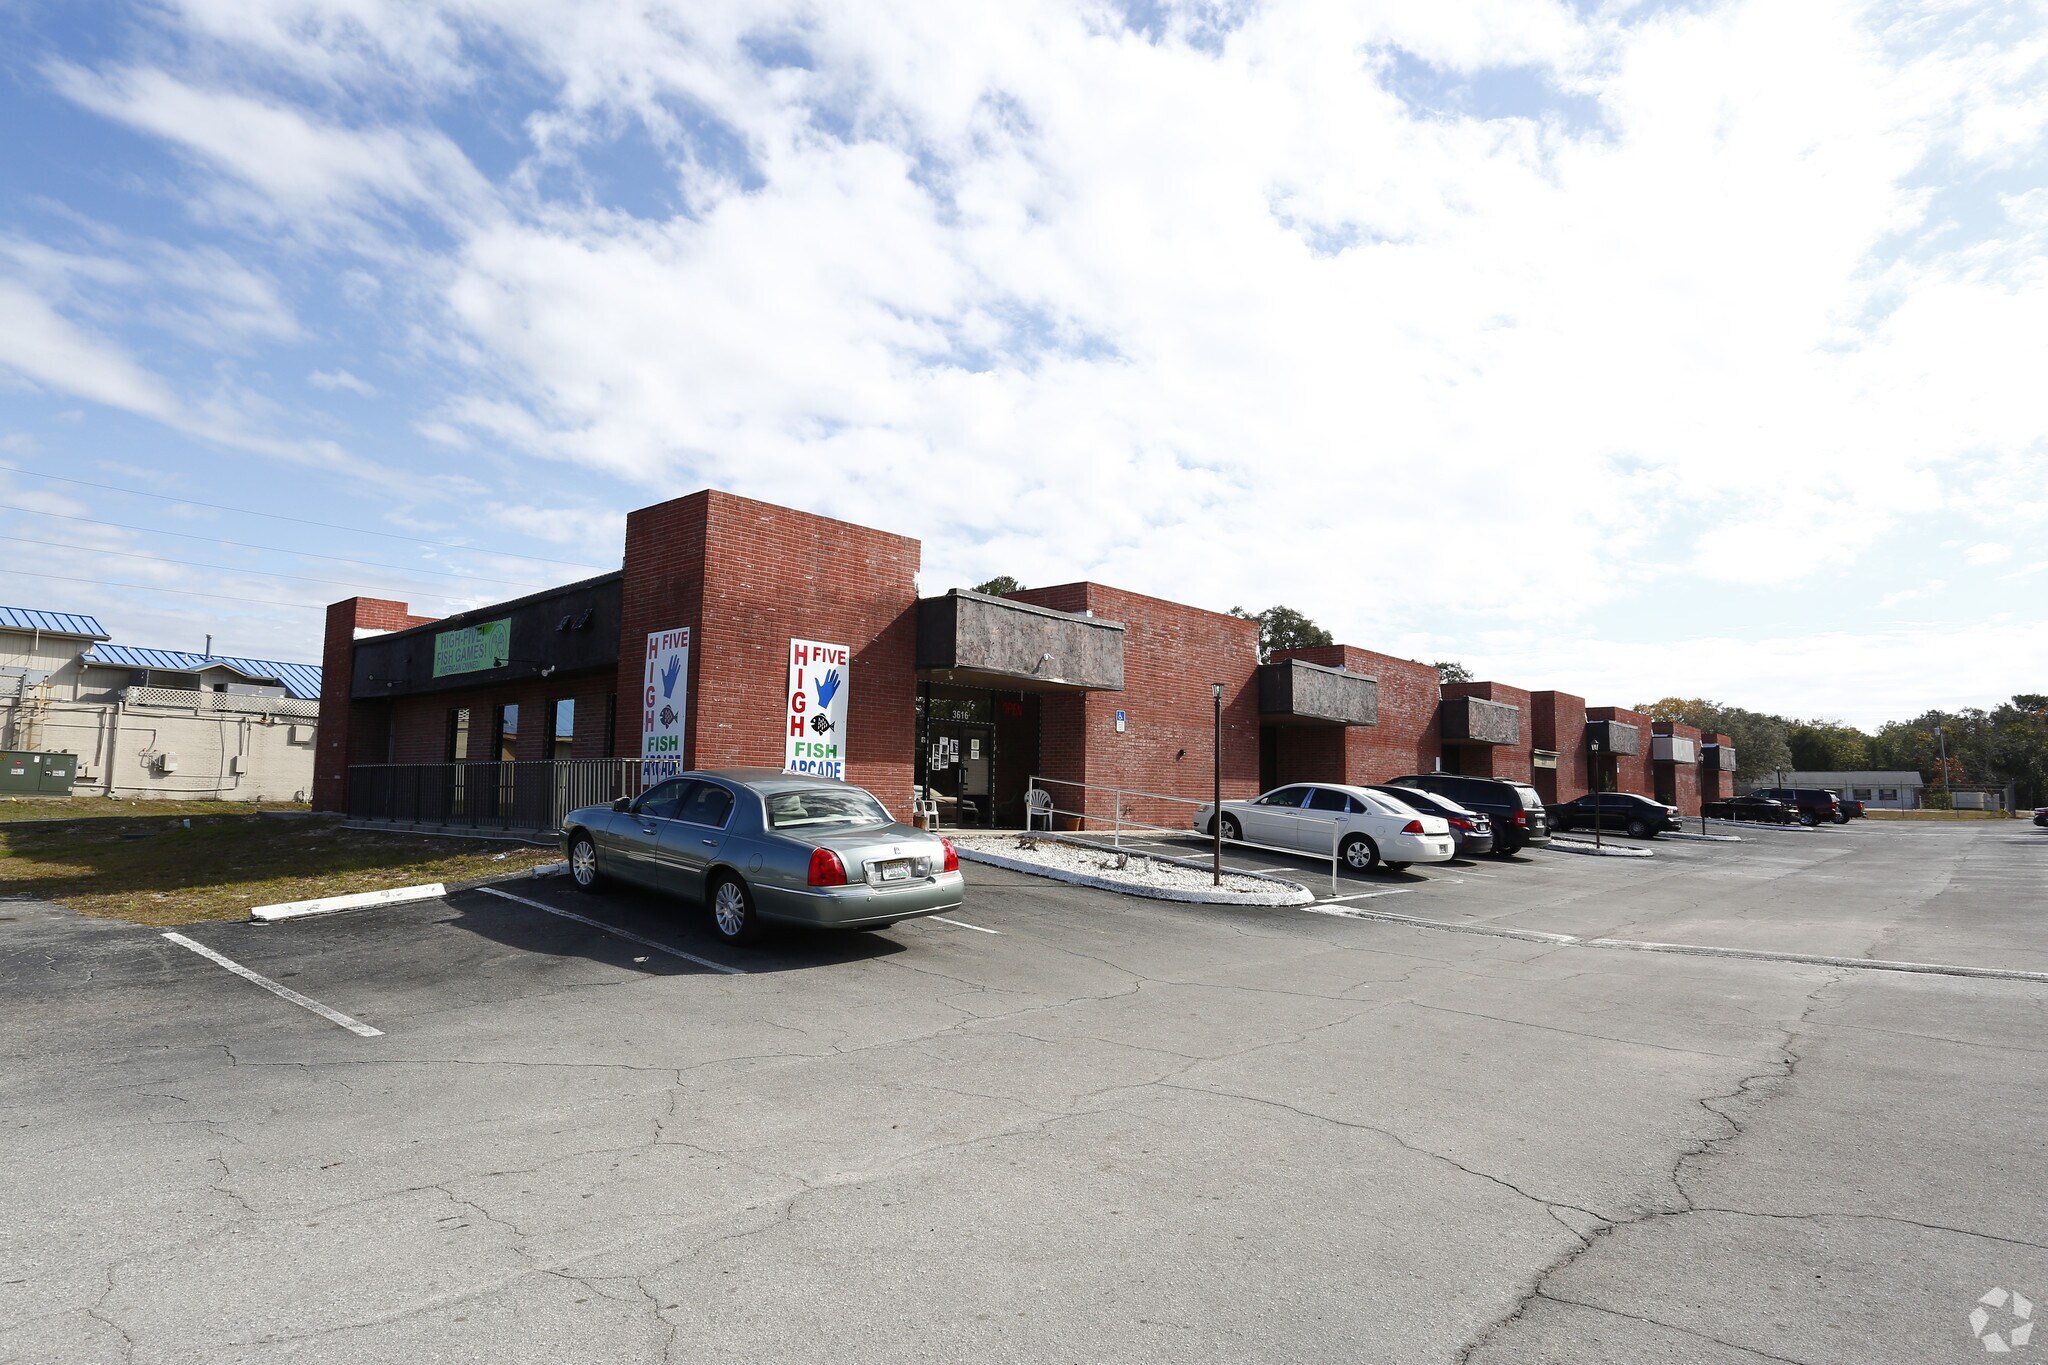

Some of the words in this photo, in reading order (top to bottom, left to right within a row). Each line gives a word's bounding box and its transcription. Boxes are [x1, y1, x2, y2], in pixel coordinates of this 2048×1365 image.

[662, 631, 688, 650] FIVE
[437, 651, 454, 666] FISH
[455, 644, 487, 662] GAMES!
[812, 646, 846, 665] FIVE
[644, 637, 658, 732] HIGH
[791, 644, 808, 737] HIGH
[952, 710, 969, 720] 3616
[648, 735, 678, 752] FISH
[795, 742, 838, 759] FISH
